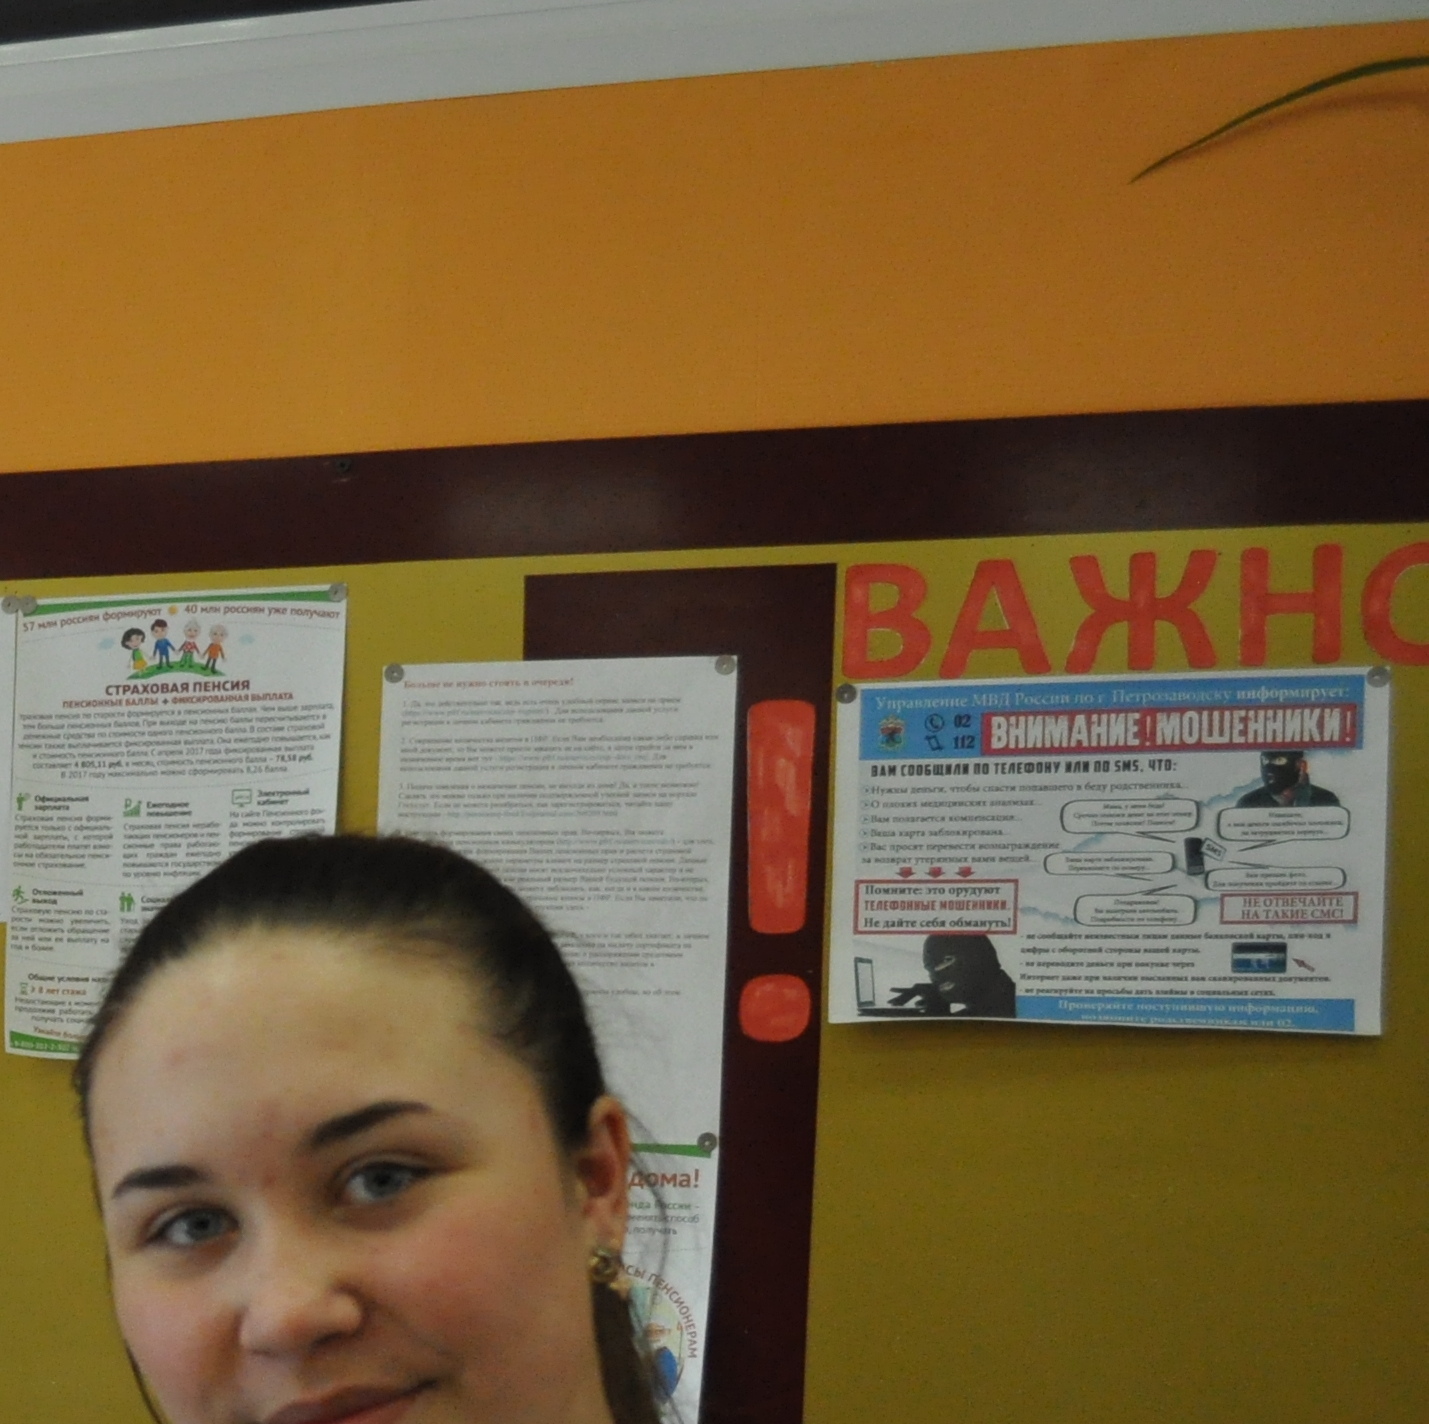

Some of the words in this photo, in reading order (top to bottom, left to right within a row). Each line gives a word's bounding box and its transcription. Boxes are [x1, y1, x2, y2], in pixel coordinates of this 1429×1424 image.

[23, 621, 35, 632] 57
[184, 605, 197, 614] 40
[104, 682, 190, 697] СТРАХОВАЯ
[193, 680, 251, 694] ПЕНСИЯ
[62, 699, 123, 709] ПЕНСИОННЫЕ
[125, 697, 159, 706] БАЛЛЫ
[171, 694, 250, 706] ФИКСИРОВАННАЯ
[251, 692, 294, 702] ВЫПЛАТА
[876, 696, 968, 713] Управление
[972, 694, 1010, 708] МВД
[1015, 692, 1070, 706] России
[1074, 693, 1094, 704] по
[1111, 687, 1232, 705] Петрозаводску
[1236, 685, 1350, 703] информирует:
[953, 713, 971, 728] 02
[953, 734, 976, 750] 112
[871, 764, 897, 778] ВАМ
[901, 762, 970, 777] СООБЩИЛИ
[973, 762, 990, 775] ПО
[993, 761, 1061, 775] ТЕЛЕФОНУ
[1064, 760, 1090, 773] ИЛИ
[1093, 759, 1110, 773] ПО
[1148, 758, 1177, 772] ЧТО:
[865, 885, 923, 895] Помните:
[926, 886, 946, 895] это
[948, 886, 1001, 897] орудуют
[864, 900, 937, 911] ТЕЛЕФОННЫЕ
[939, 899, 1011, 911] МОШЕННИКИ.
[1242, 897, 1261, 908] НЕ
[1241, 909, 1260, 920] НА
[1262, 909, 1308, 920] ТАКИЕ
[864, 918, 880, 928] Не
[882, 918, 917, 929] дайте
[919, 917, 946, 928] себя
[949, 917, 1011, 931] обмануть!
[648, 1273, 698, 1358] ПЕНСИОНЕРАМ
